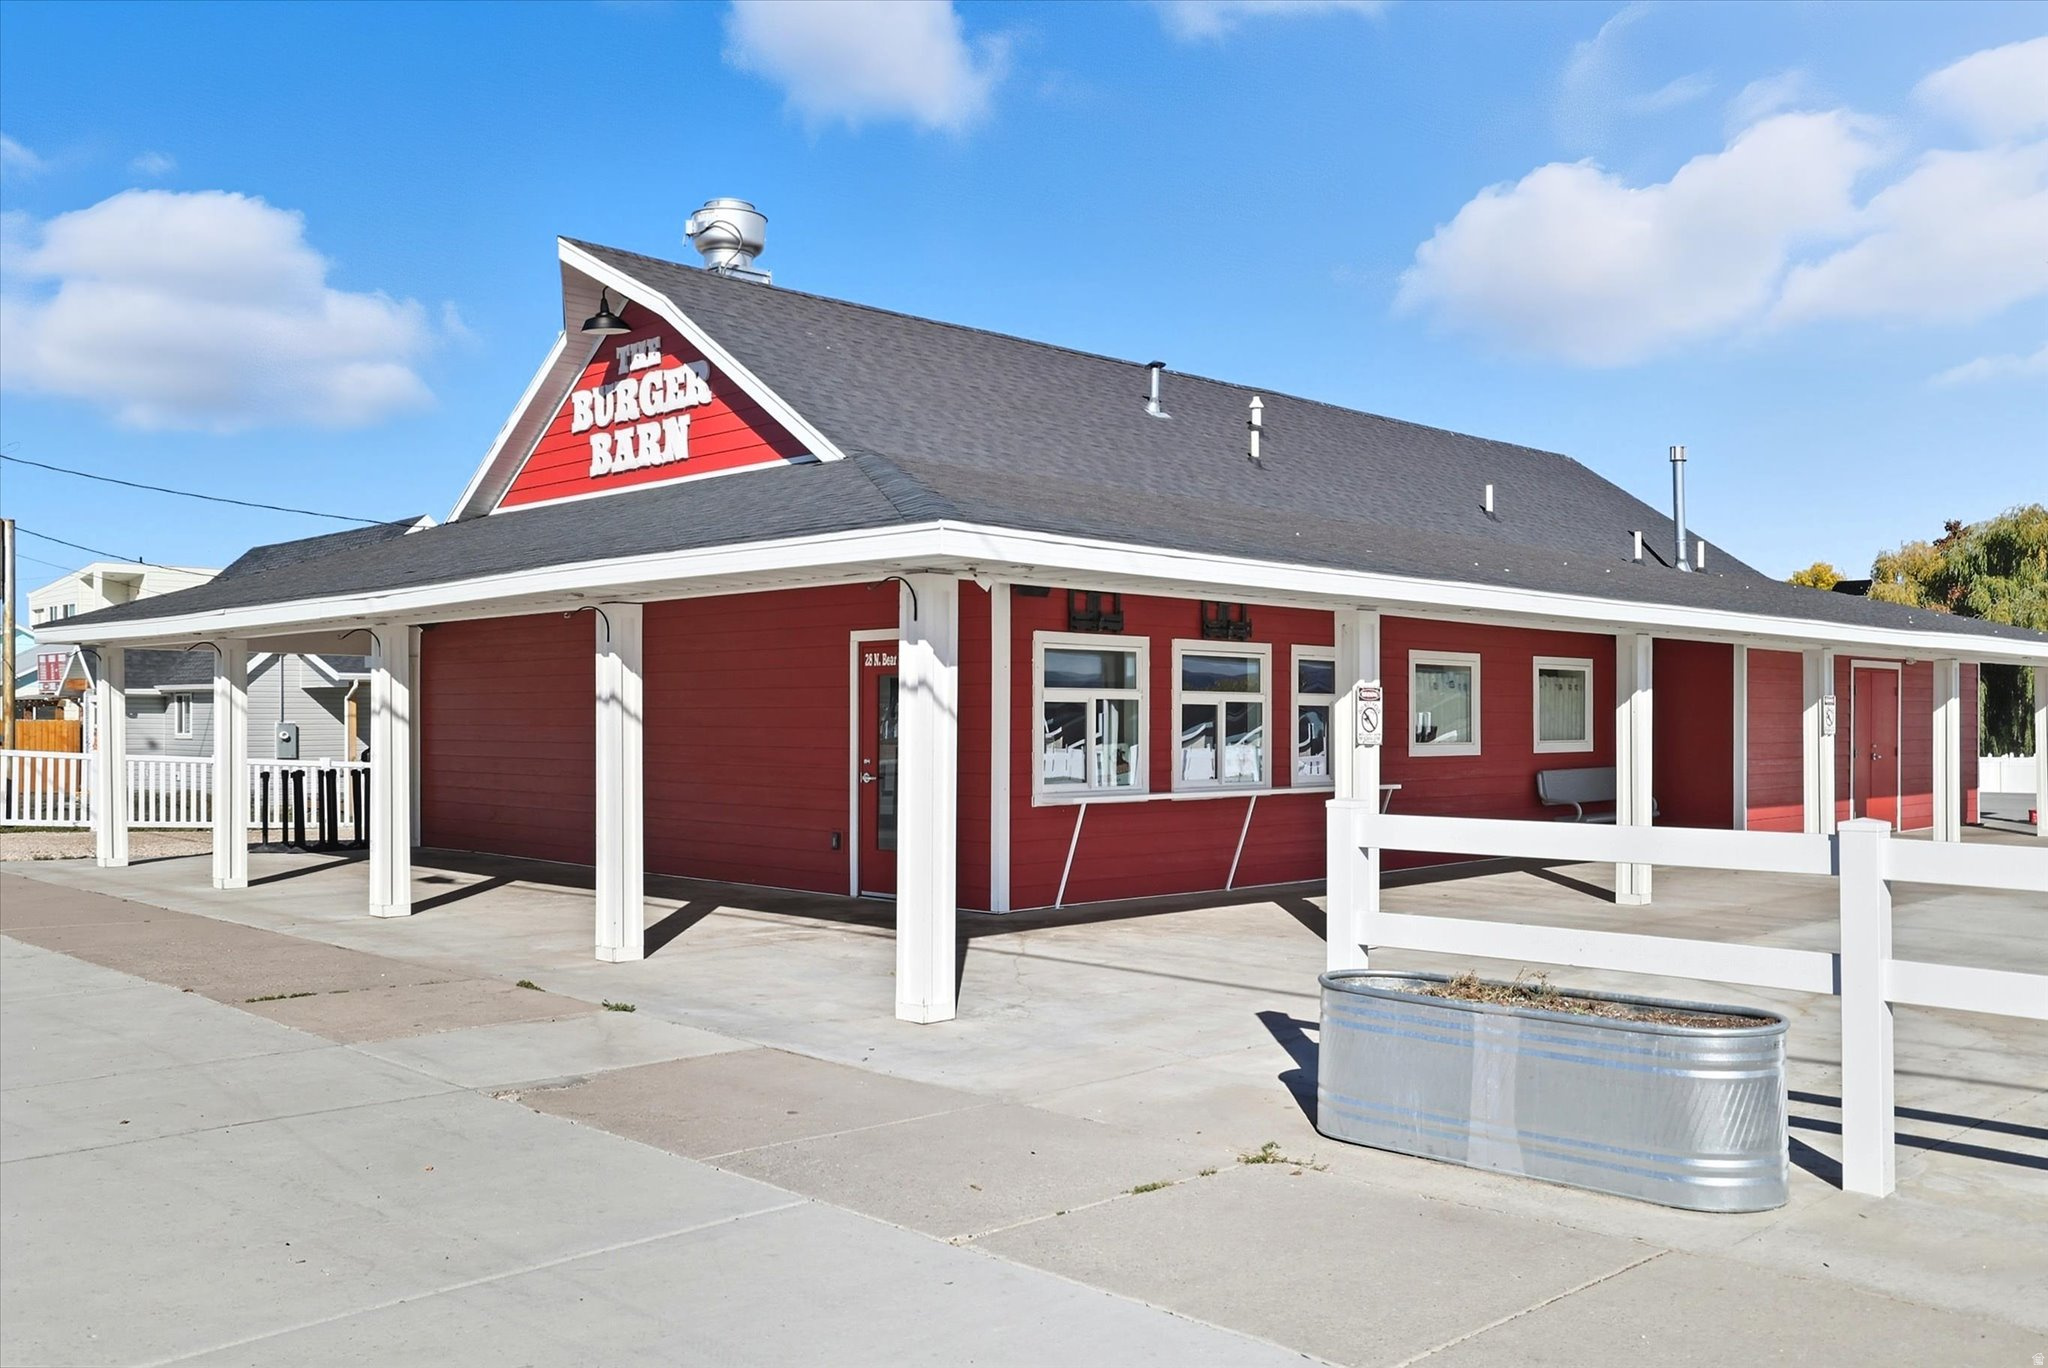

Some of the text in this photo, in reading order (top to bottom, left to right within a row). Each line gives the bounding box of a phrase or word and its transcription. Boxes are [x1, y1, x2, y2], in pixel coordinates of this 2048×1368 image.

[616, 336, 661, 375] THE
[571, 360, 712, 434] BURGER
[589, 414, 691, 478] BARN
[882, 653, 897, 666] Bear
